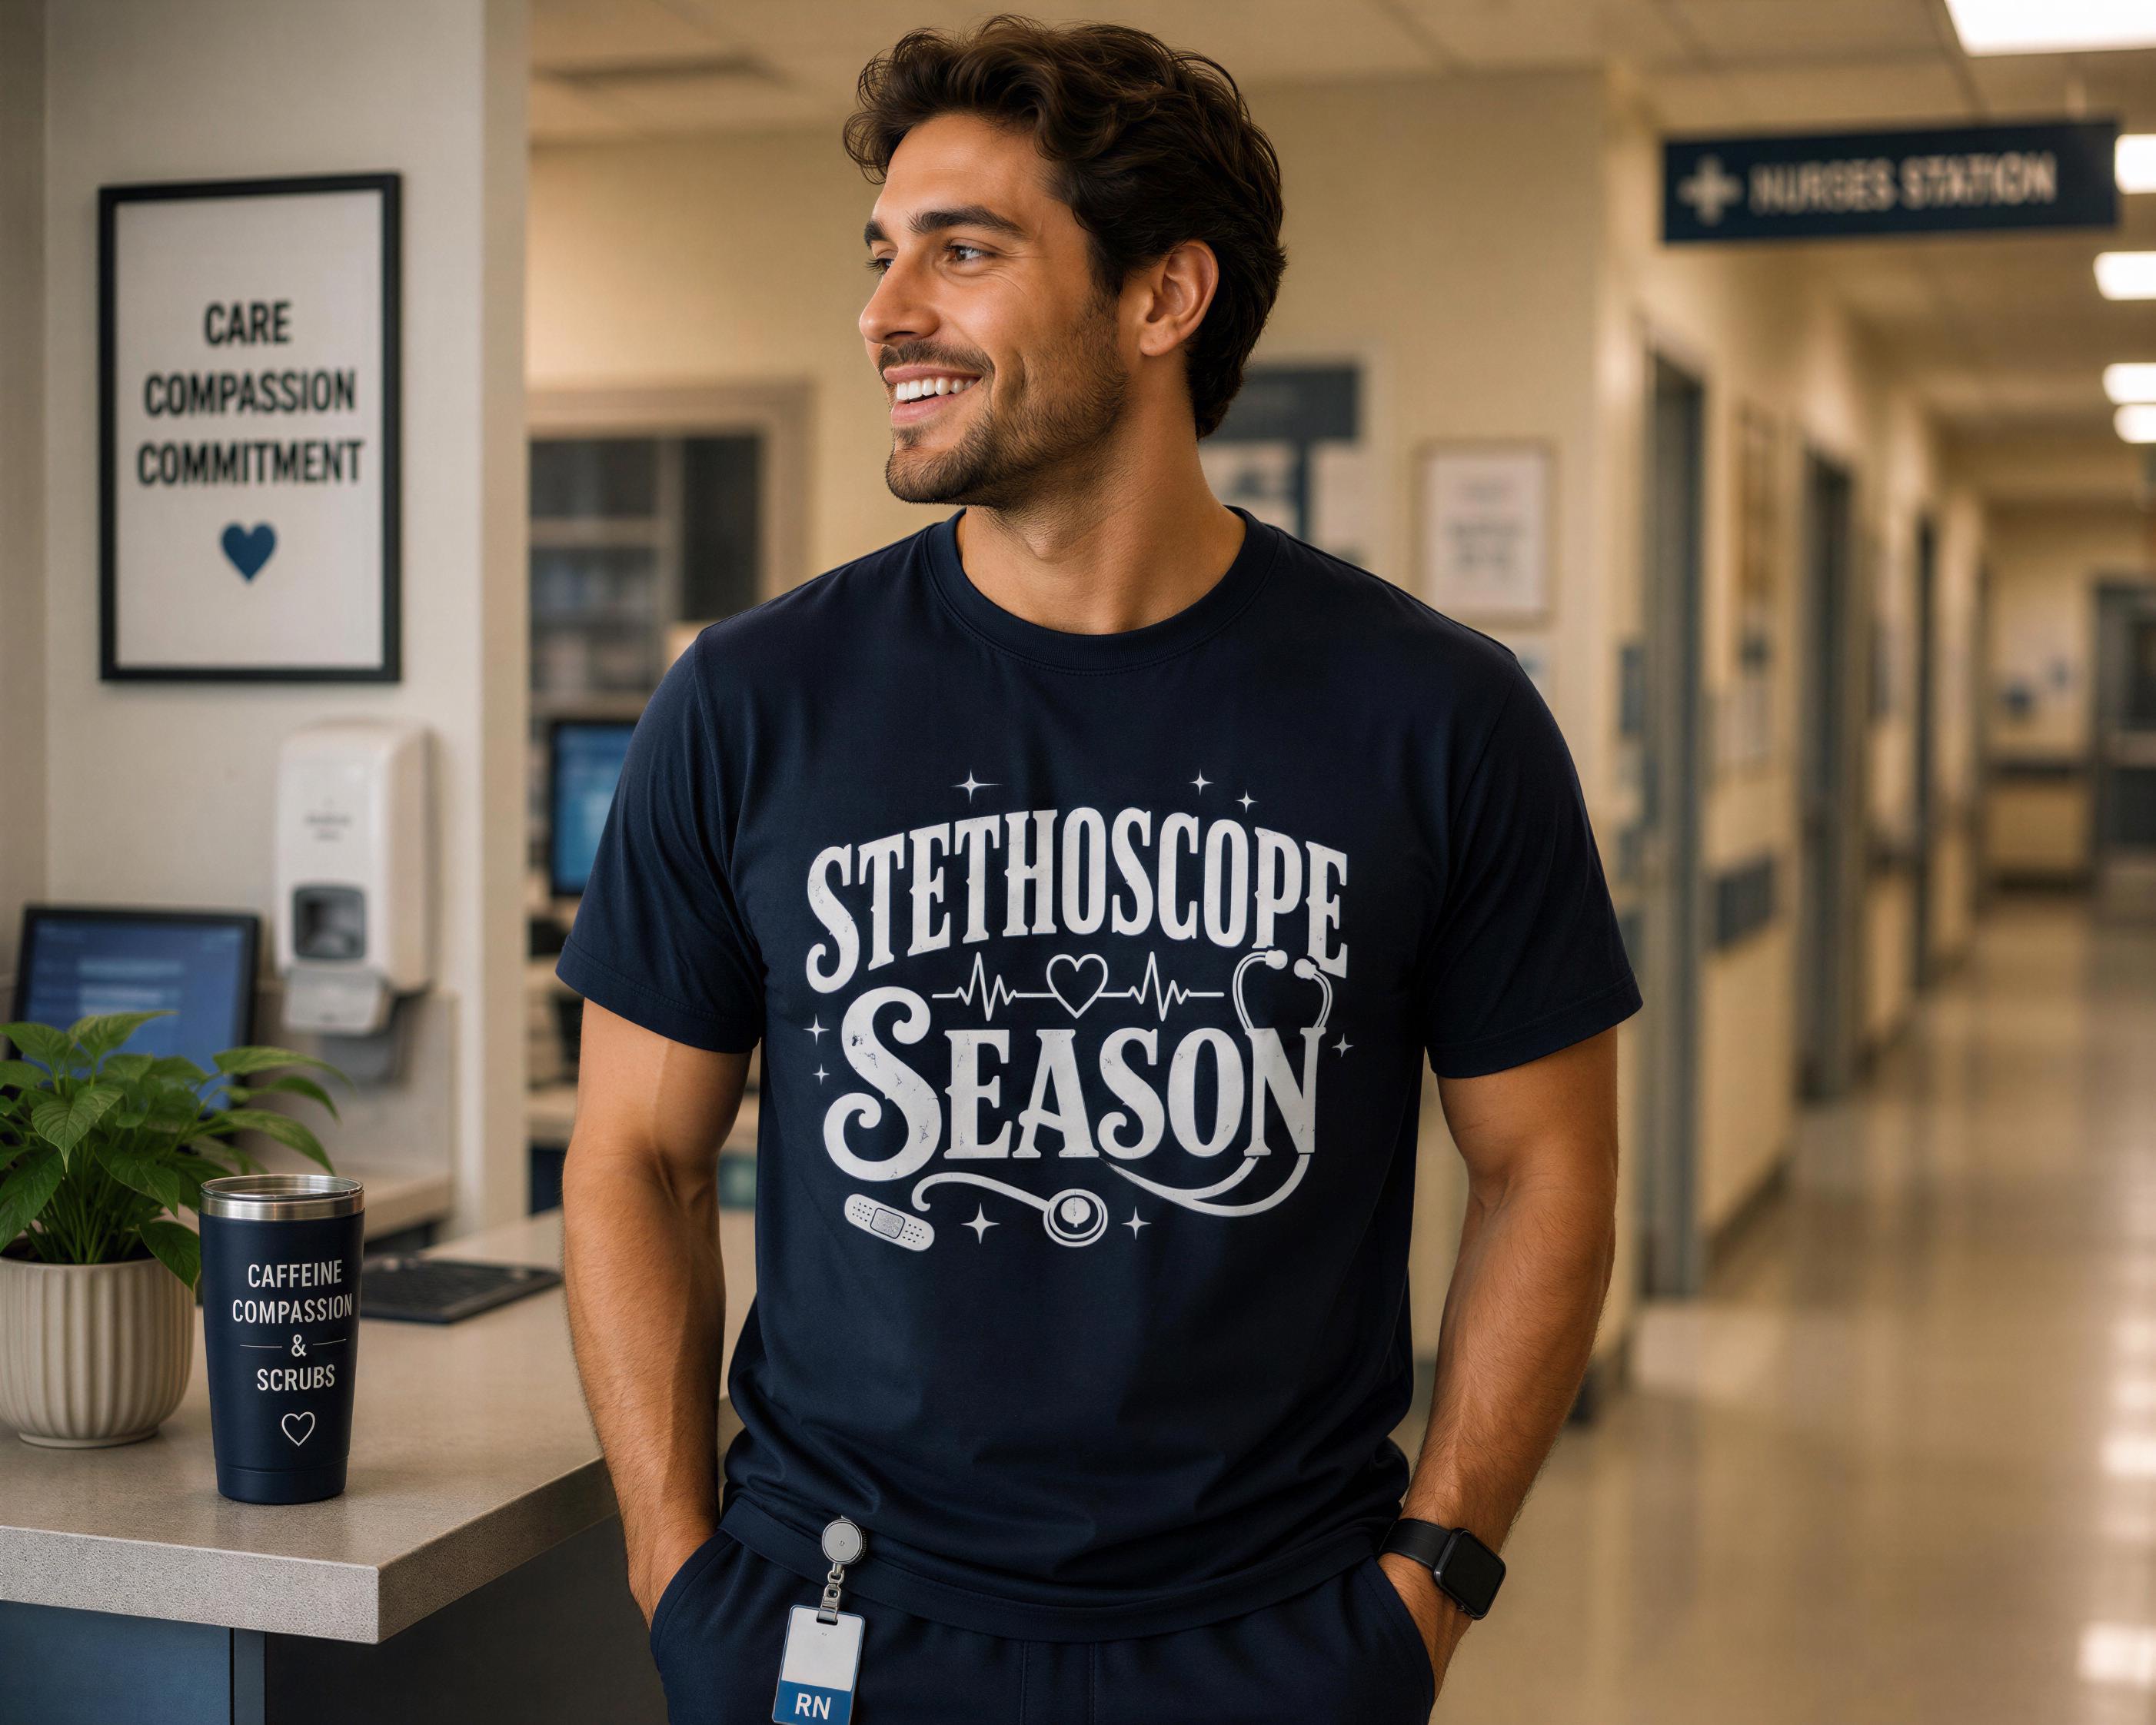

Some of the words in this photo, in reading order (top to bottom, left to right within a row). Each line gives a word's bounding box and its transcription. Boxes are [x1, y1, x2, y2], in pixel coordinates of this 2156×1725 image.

[1902, 151, 2055, 209] STATION
[205, 300, 292, 346] CARE
[145, 371, 356, 416] COMPASSION
[138, 440, 362, 485] COMMITMENT
[806, 806, 1348, 994] STETHOSCOPE
[248, 1259, 343, 1288] CAFFEINE
[232, 1293, 353, 1325] COMPASSION
[291, 1334, 308, 1358] &
[256, 1364, 335, 1392] SCRUBS
[794, 1693, 831, 1720] RN
